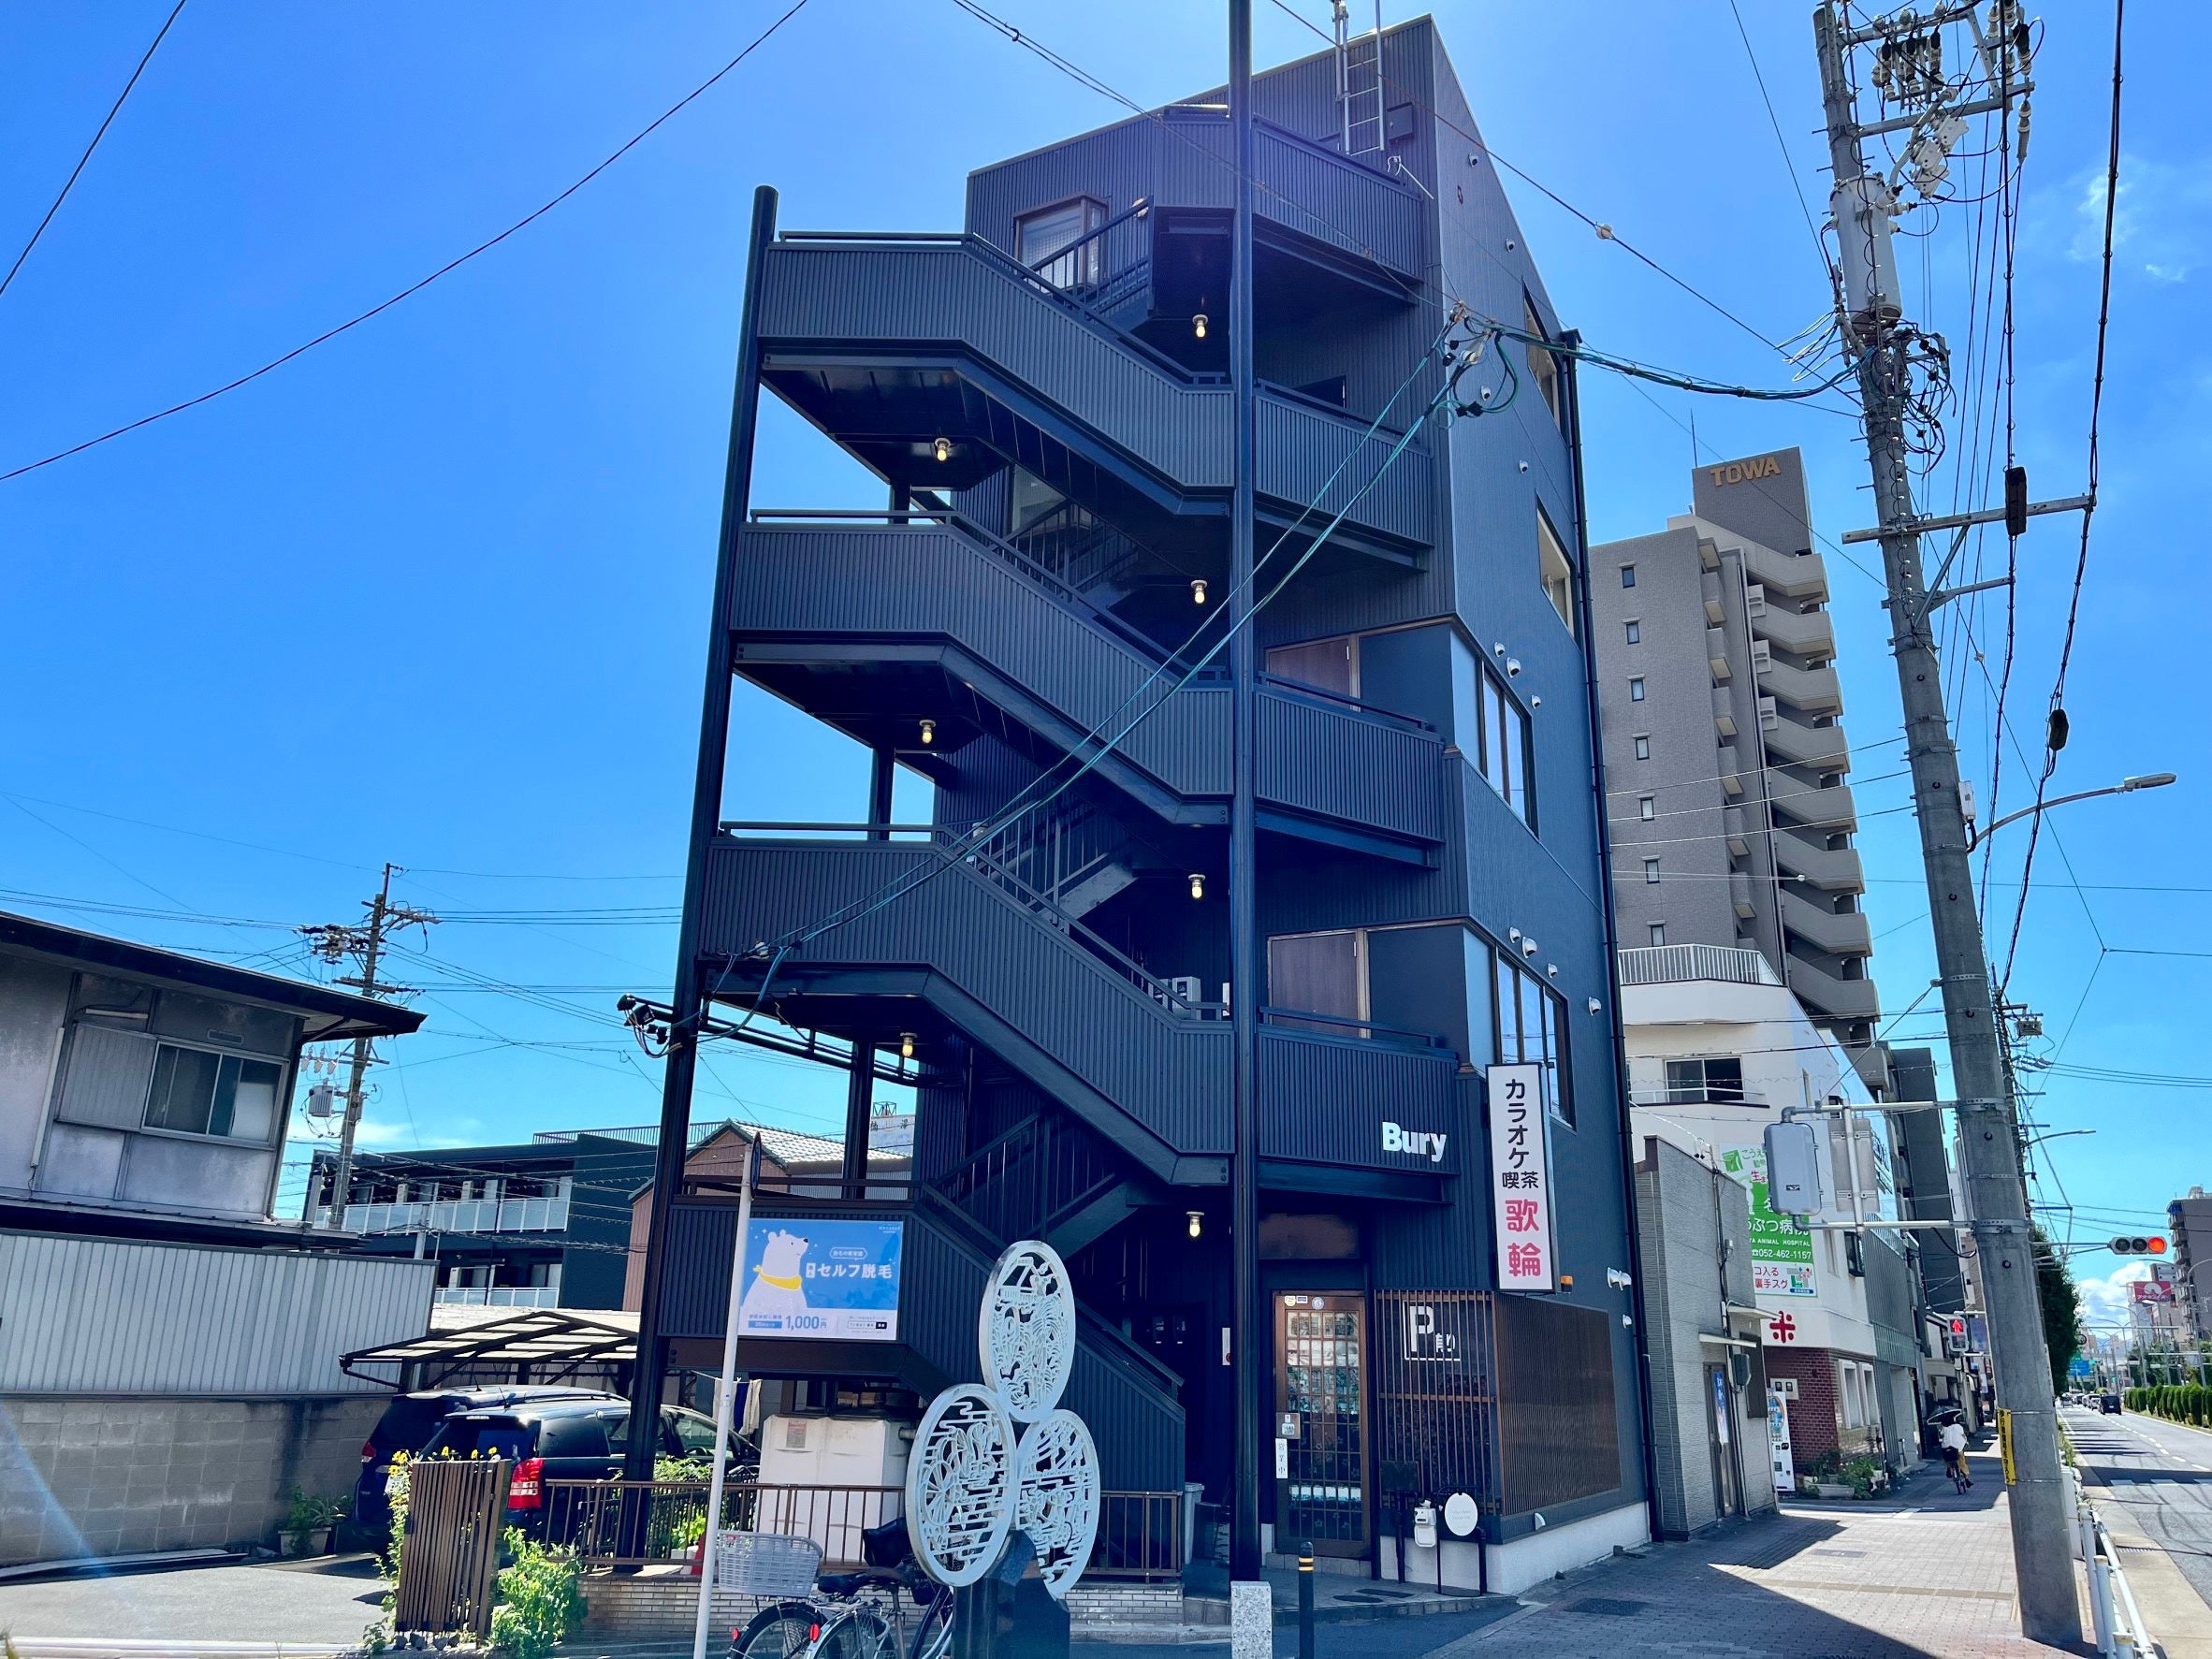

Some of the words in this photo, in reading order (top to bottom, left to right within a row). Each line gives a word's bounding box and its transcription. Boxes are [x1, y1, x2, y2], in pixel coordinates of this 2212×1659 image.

[1710, 457, 1782, 487] TOWA
[1382, 1121, 1447, 1162] Bury
[1505, 1079, 1530, 1169] カラオケ
[1503, 1171, 1539, 1189] 喫茶
[1505, 1199, 1541, 1277] 歌輪
[818, 1263, 892, 1279] セルフ脱毛
